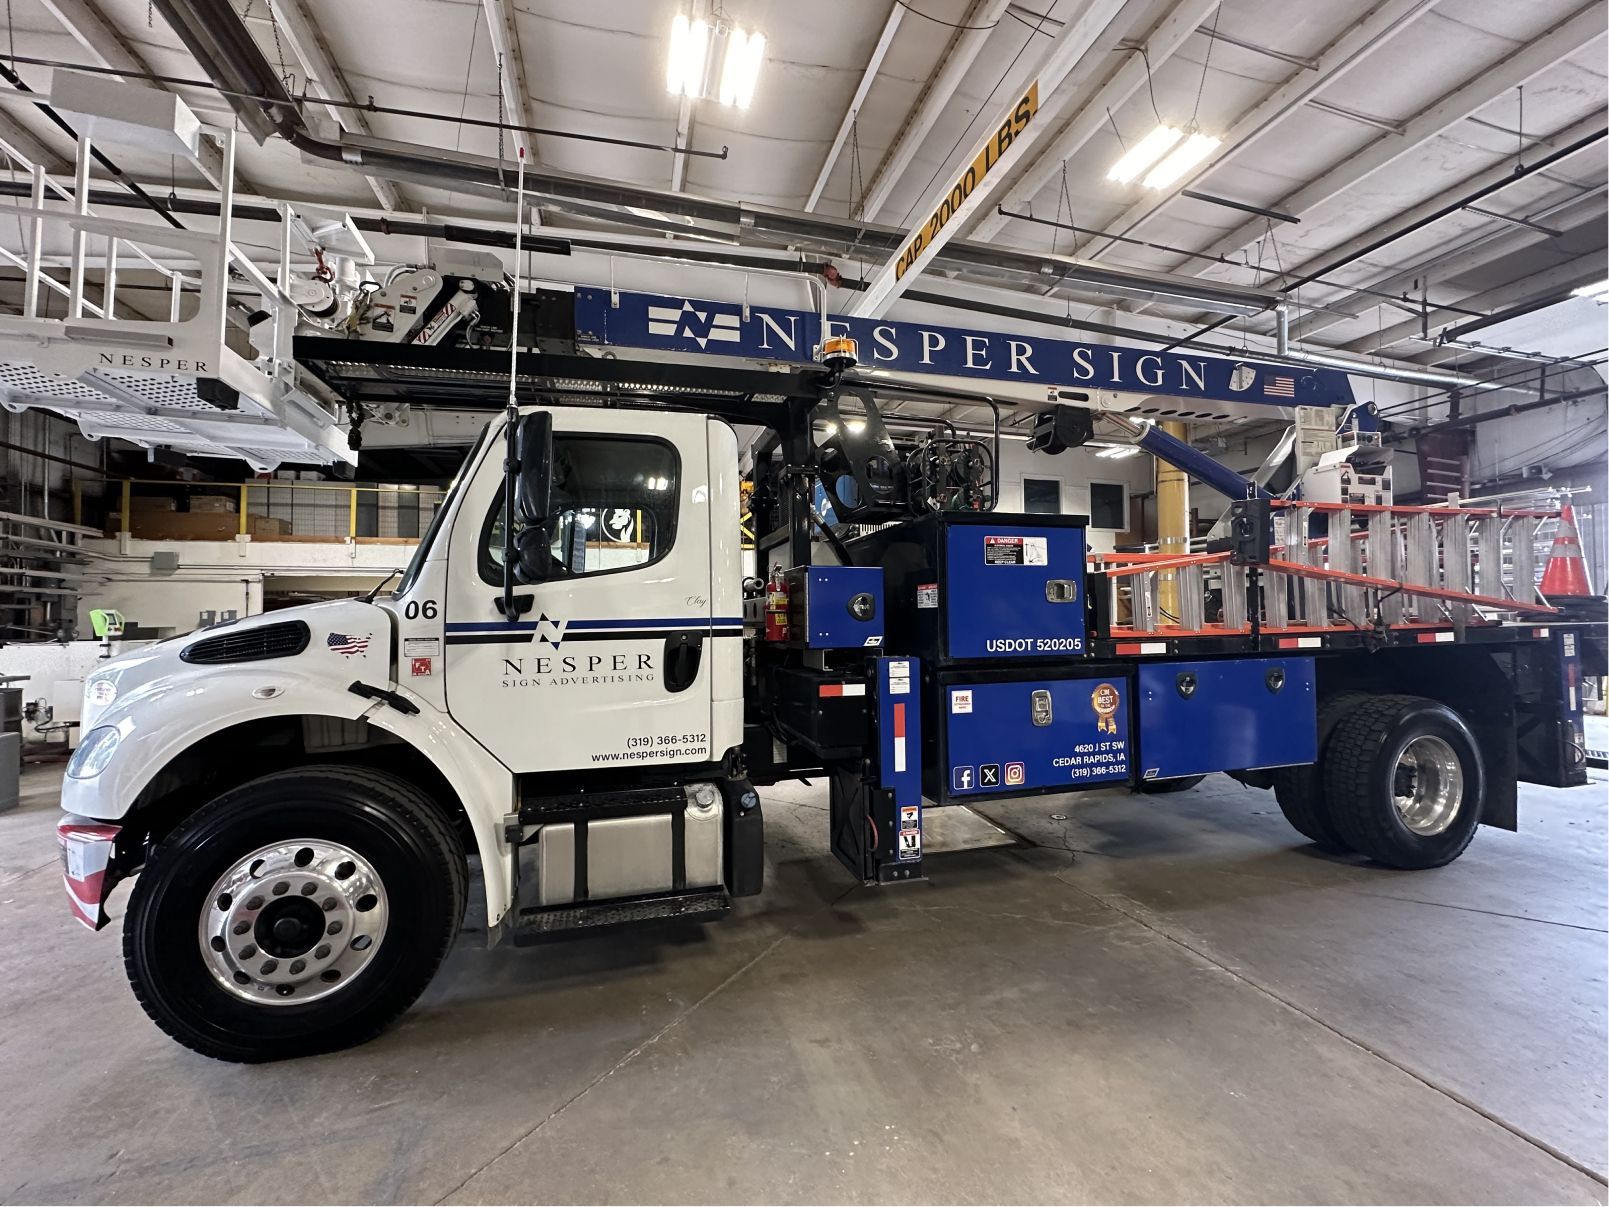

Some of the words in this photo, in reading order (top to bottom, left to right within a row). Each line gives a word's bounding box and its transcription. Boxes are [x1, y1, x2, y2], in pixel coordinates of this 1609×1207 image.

[930, 166, 976, 240] 2000
[99, 353, 208, 372] NESPER
[1072, 348, 1207, 391] SIGN
[405, 600, 438, 620] 06
[986, 639, 1034, 652] USDOT
[1036, 638, 1081, 651] 520205
[502, 654, 654, 676] NESPER
[502, 679, 541, 688] SIGN
[549, 674, 655, 686] ADVERTISING
[627, 736, 654, 749] (319)
[657, 733, 706, 745] 366-5312
[1074, 744, 1094, 753] 4620
[1100, 742, 1110, 751] ST
[1112, 741, 1125, 750] SW
[591, 747, 707, 762] www.nespersign.com
[1053, 756, 1082, 767] CEDAR
[1083, 753, 1116, 764] RAPIDS,
[1117, 752, 1126, 761] IA
[1071, 767, 1090, 779] (319)
[1092, 764, 1126, 775] 366-5312
